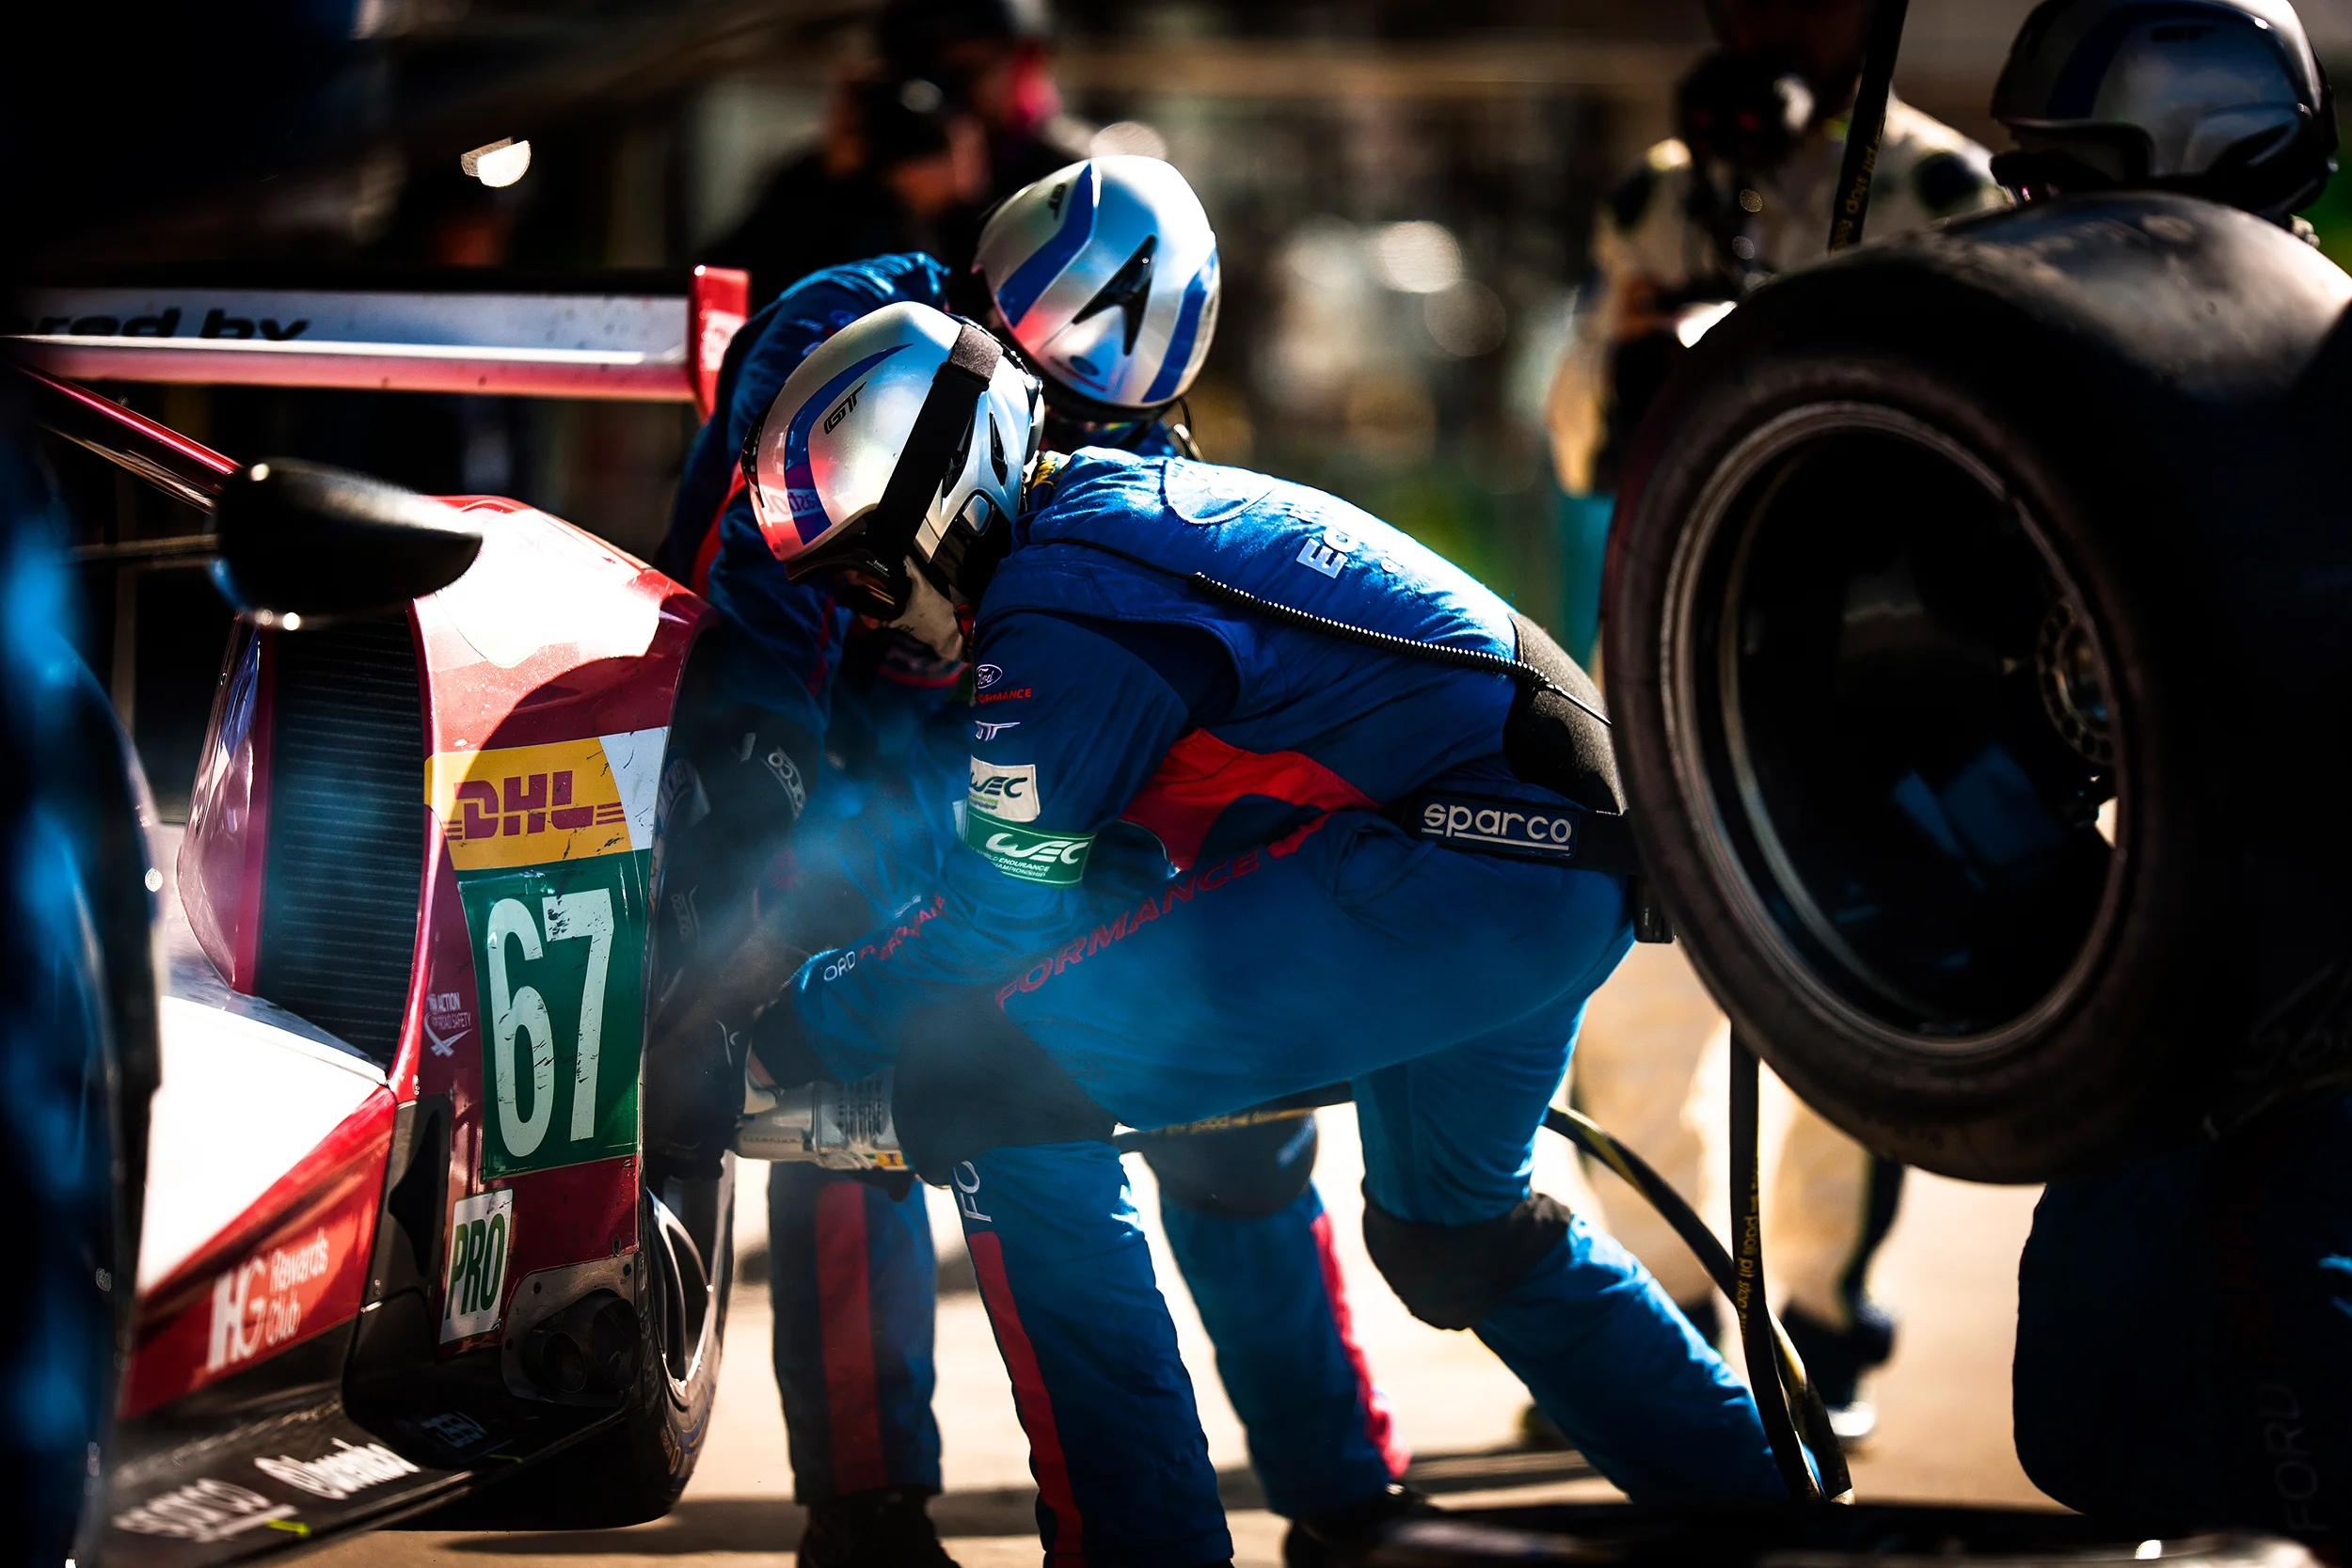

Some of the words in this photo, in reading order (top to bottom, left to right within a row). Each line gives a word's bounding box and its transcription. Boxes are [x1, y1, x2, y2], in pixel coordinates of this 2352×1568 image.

[823, 381, 867, 435] GT
[453, 770, 595, 840] DHL
[1422, 803, 1573, 844] sparco
[985, 832, 1089, 865] WEC
[998, 856, 1051, 872] ENDURANCE
[486, 887, 615, 1158] 67
[445, 1212, 505, 1321] PRO
